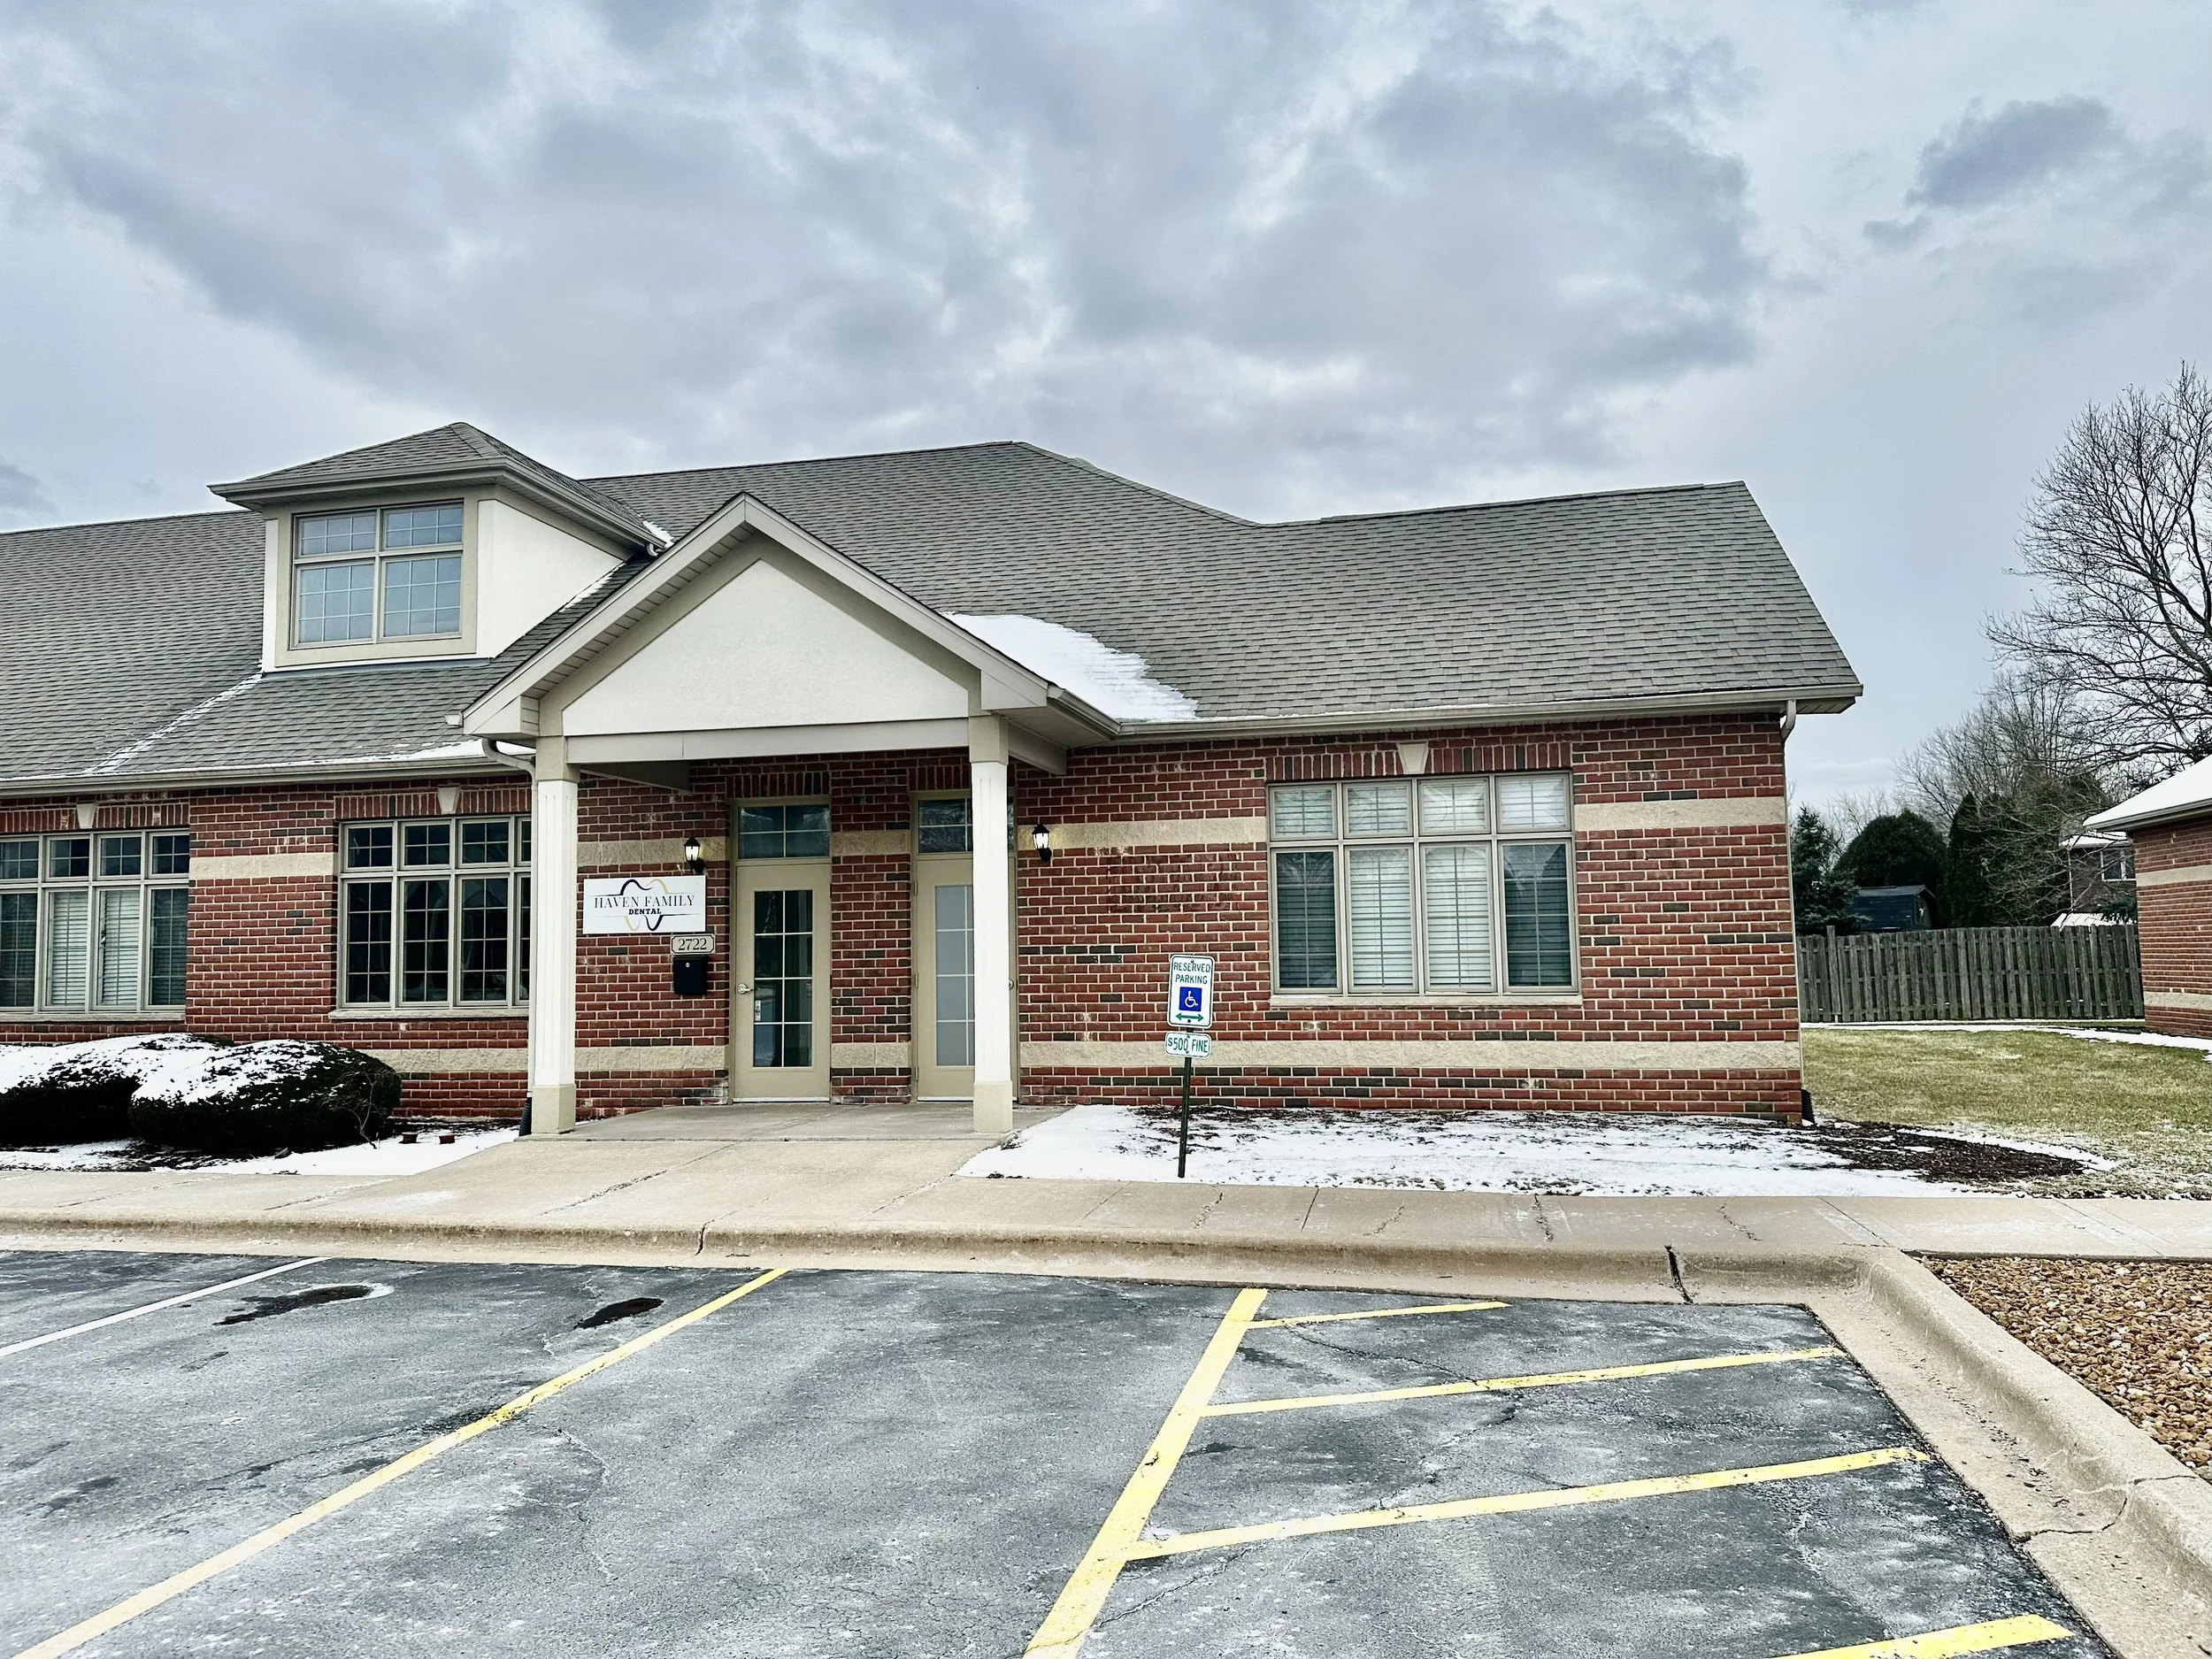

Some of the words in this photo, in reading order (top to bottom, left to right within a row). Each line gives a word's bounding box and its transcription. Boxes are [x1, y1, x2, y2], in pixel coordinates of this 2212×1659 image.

[595, 896, 640, 909] HAVEN
[644, 895, 695, 907] FAMILY
[678, 938, 707, 951] 2722
[1173, 962, 1211, 973] RESERVED
[1175, 974, 1208, 985] PARKING
[1192, 1039, 1209, 1053] FINE
